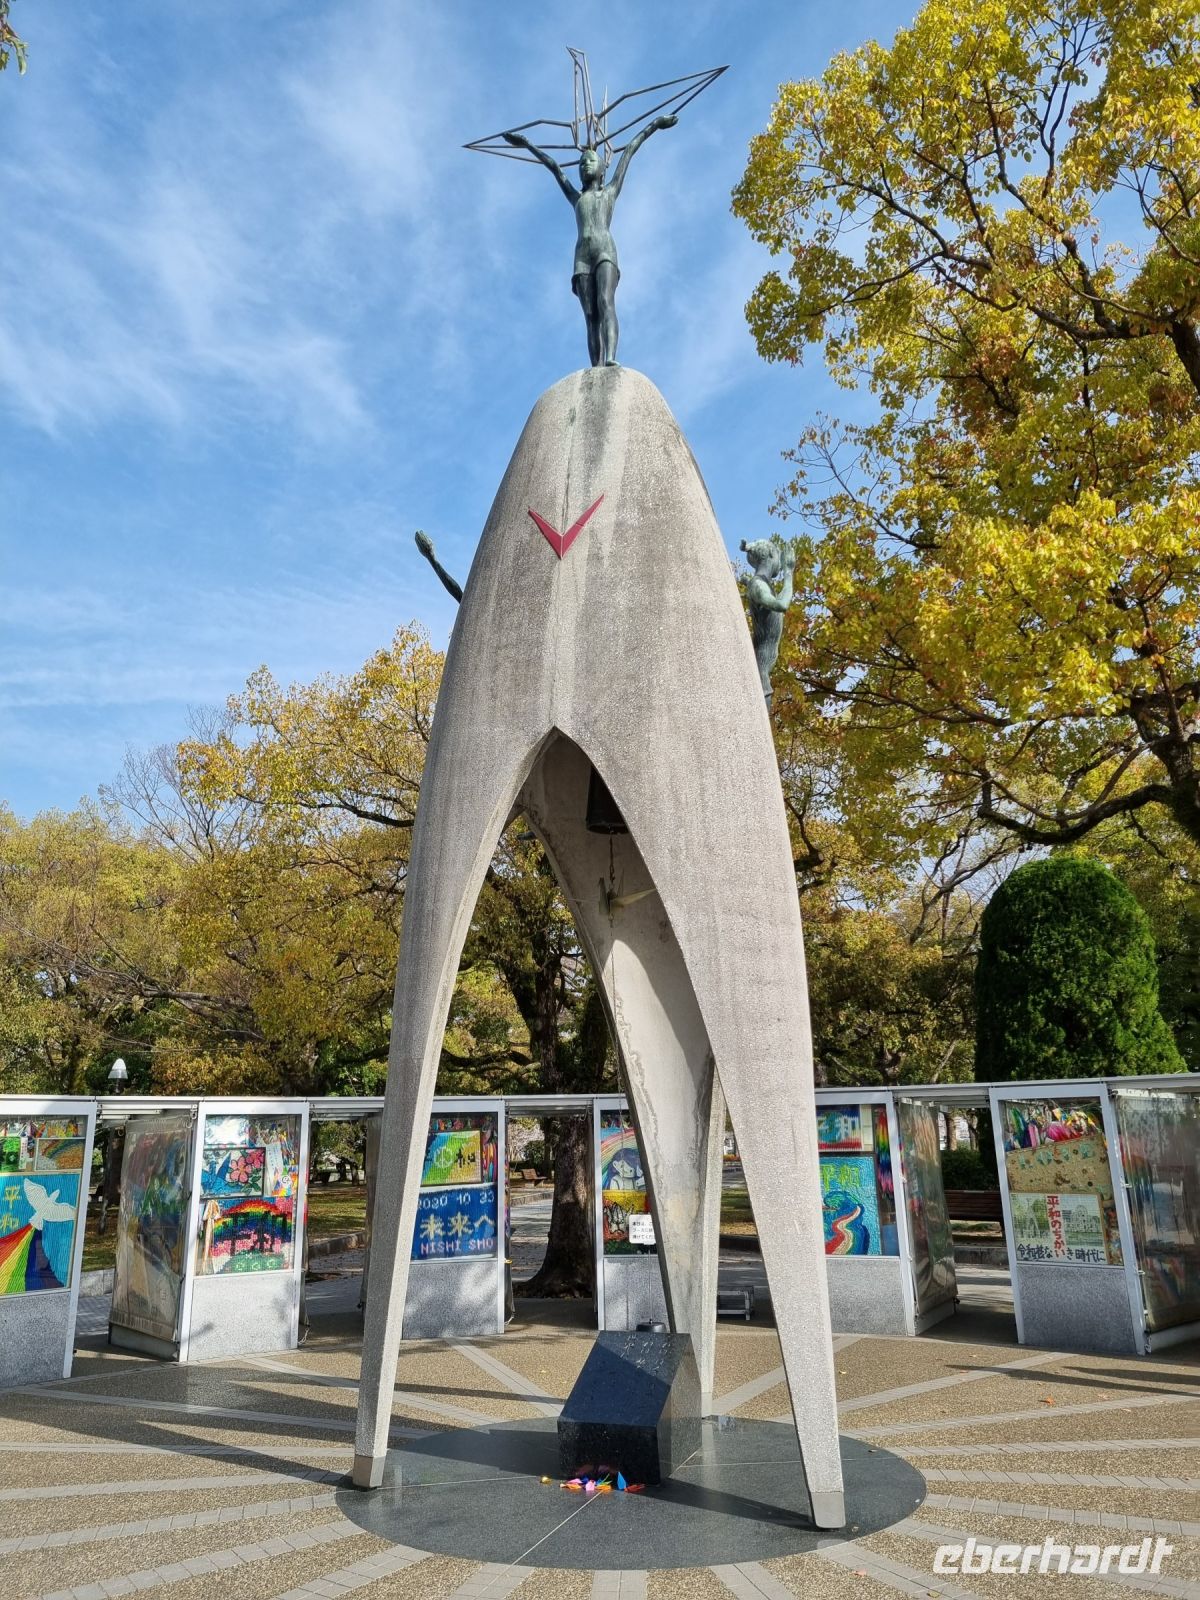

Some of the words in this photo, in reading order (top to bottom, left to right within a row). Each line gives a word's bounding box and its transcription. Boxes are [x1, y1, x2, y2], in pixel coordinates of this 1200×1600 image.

[420, 1211, 496, 1240] 未来へ
[1046, 1195, 1066, 1258] 平和のちかい
[420, 1240, 462, 1255] NISHI
[468, 1237, 494, 1251] SHO
